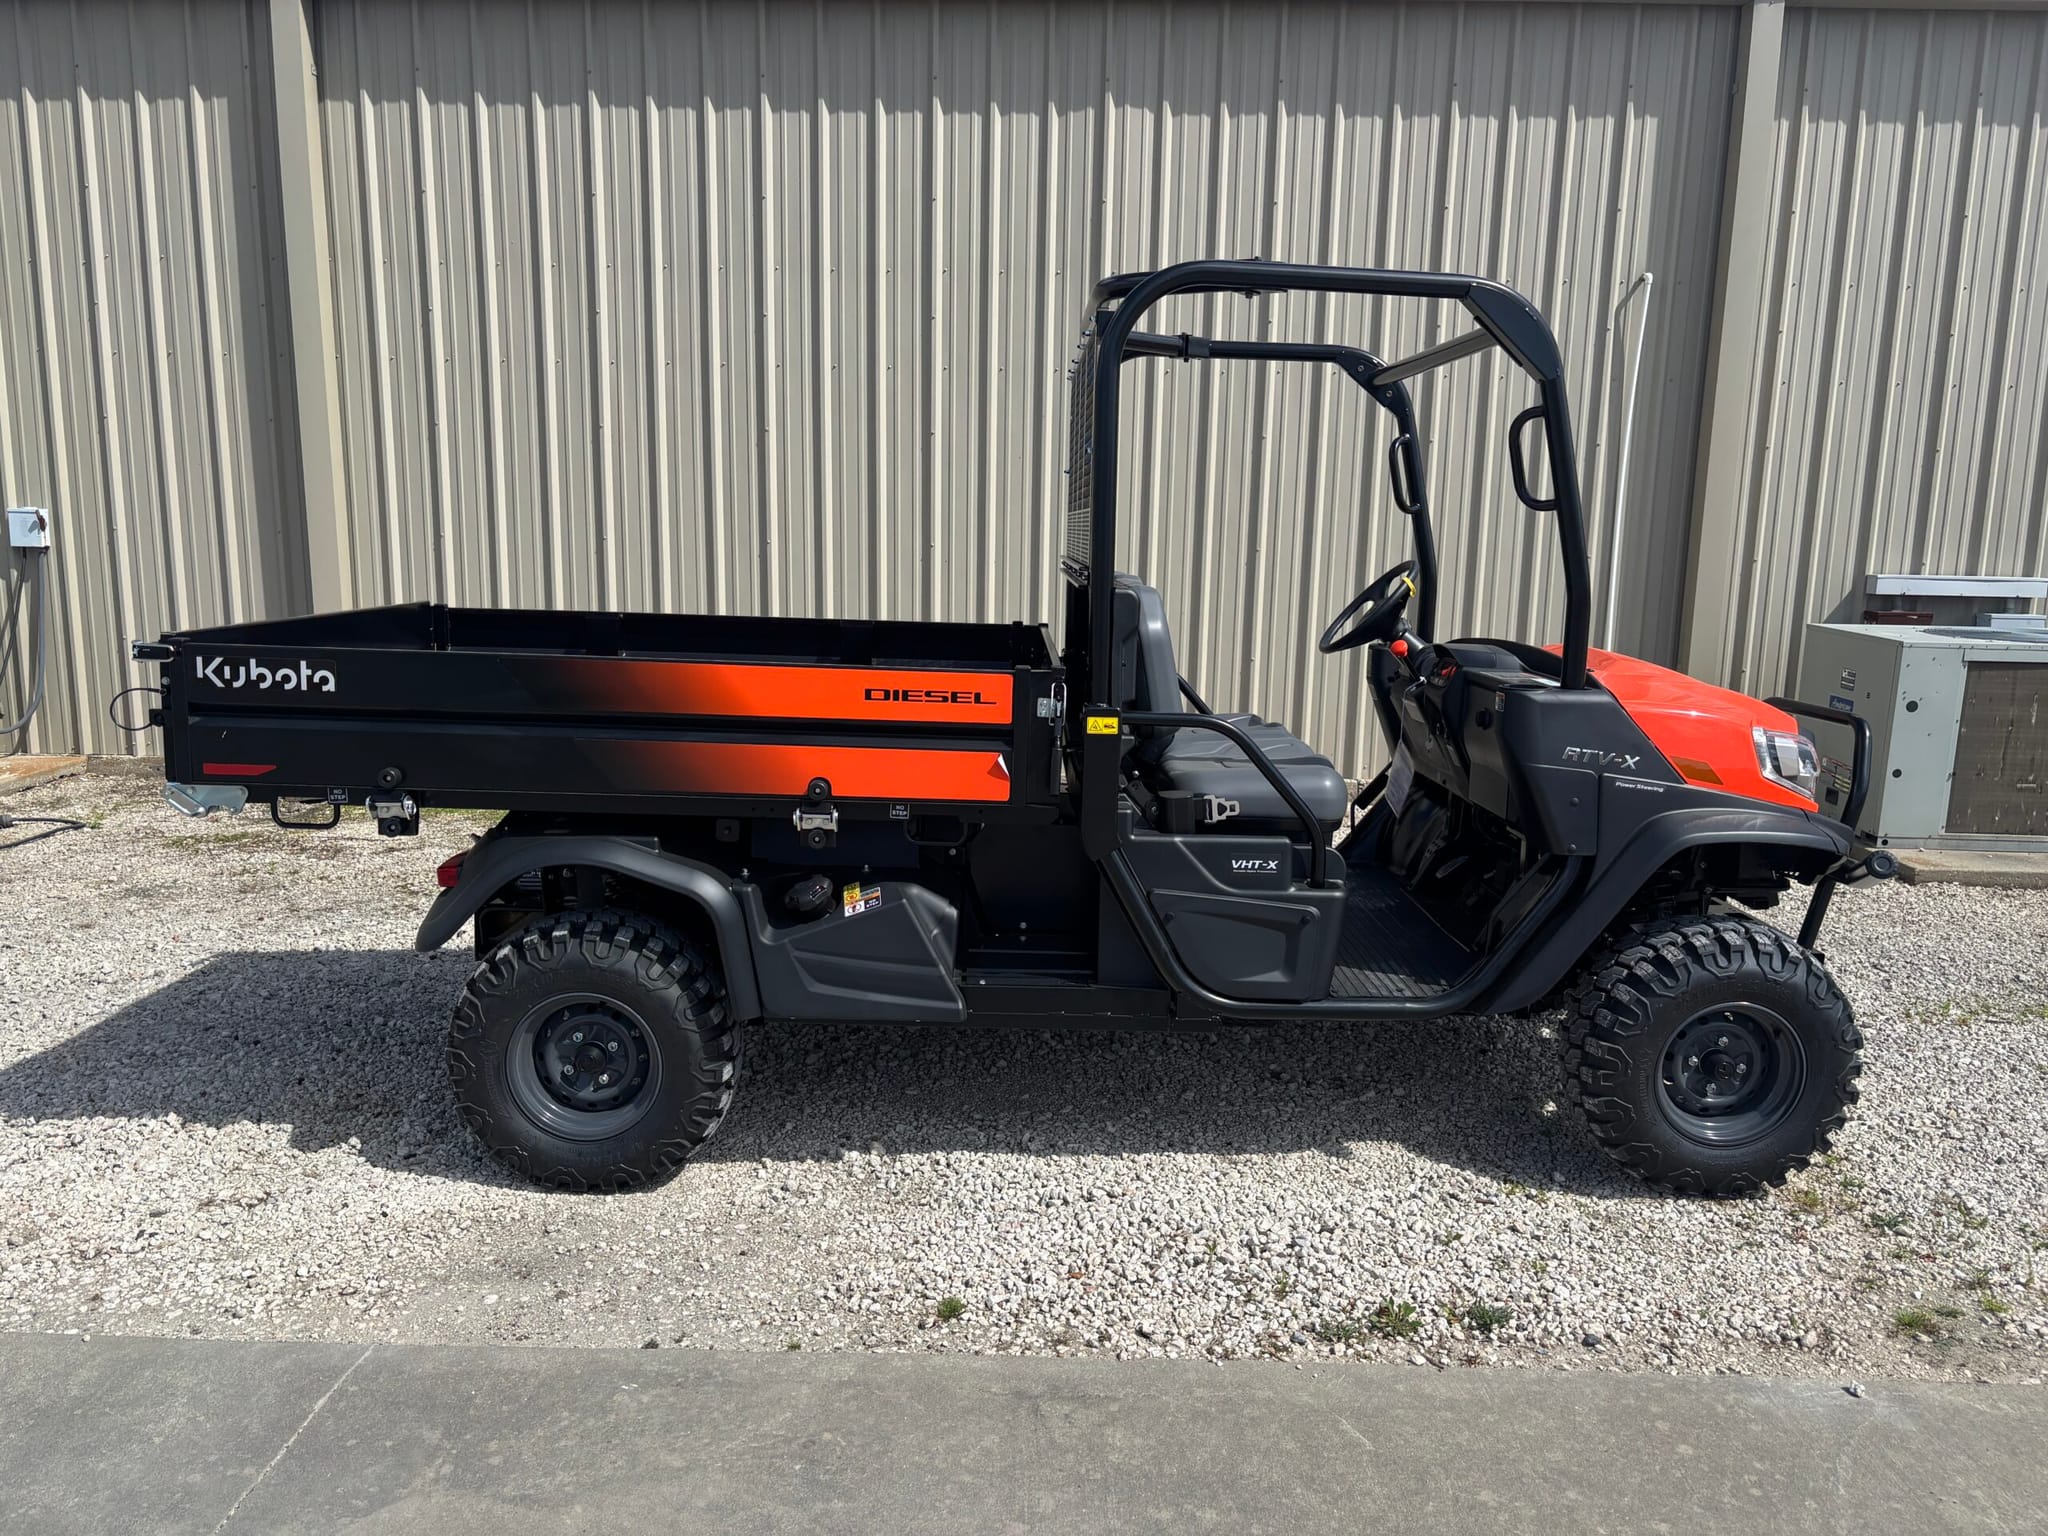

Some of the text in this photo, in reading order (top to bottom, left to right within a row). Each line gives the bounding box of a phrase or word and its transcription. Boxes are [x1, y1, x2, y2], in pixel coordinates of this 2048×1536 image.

[196, 656, 336, 692] Kubota
[864, 688, 997, 705] DIESEL
[1562, 746, 1641, 770] RTV-X
[1615, 781, 1664, 793] Power Steering
[1232, 860, 1279, 869] VHT-X
